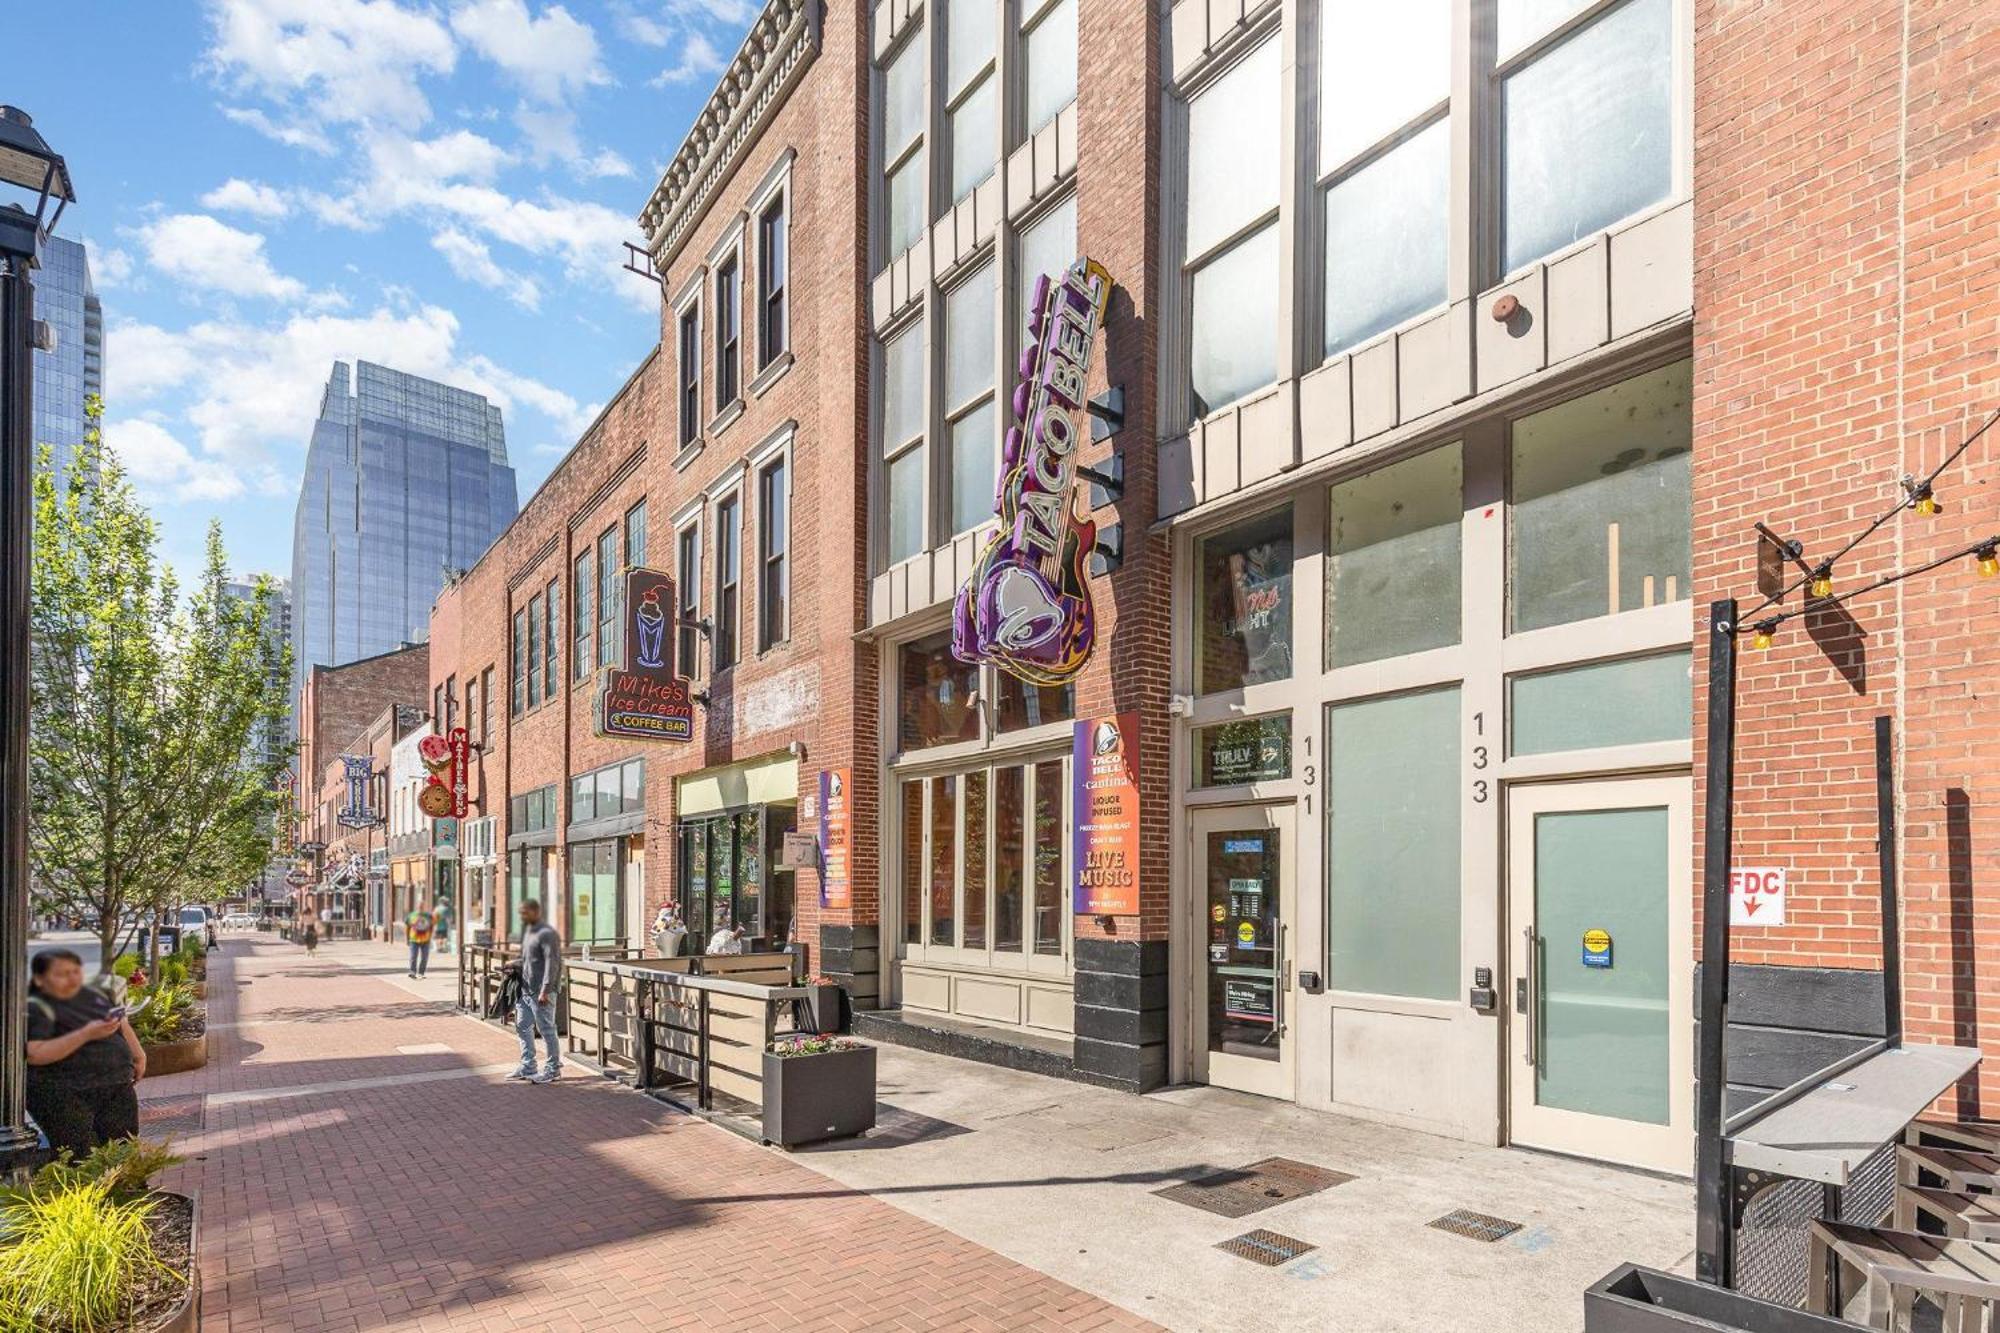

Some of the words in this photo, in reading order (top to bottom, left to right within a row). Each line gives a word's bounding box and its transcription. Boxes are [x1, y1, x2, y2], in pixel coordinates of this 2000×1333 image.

[1043, 267, 1104, 410] BELL
[1012, 405, 1078, 556] TACO
[616, 675, 684, 701] Mike's
[610, 694, 635, 711] Ice
[638, 697, 689, 717] Cream
[623, 716, 664, 729] COFFEE
[666, 722, 687, 732] BAR
[1091, 755, 1121, 766] TACO
[1212, 747, 1251, 765] TRULY
[1473, 711, 1488, 803] 133
[348, 767, 368, 778] BIG
[1092, 765, 1122, 775] BELL
[1304, 735, 1316, 815] 131
[1092, 796, 1120, 805] LIQUOR
[1092, 806, 1122, 816] INFUSED
[1086, 850, 1125, 868] LIVE
[1079, 869, 1133, 888] MUSIC
[1728, 871, 1780, 894] FDC
